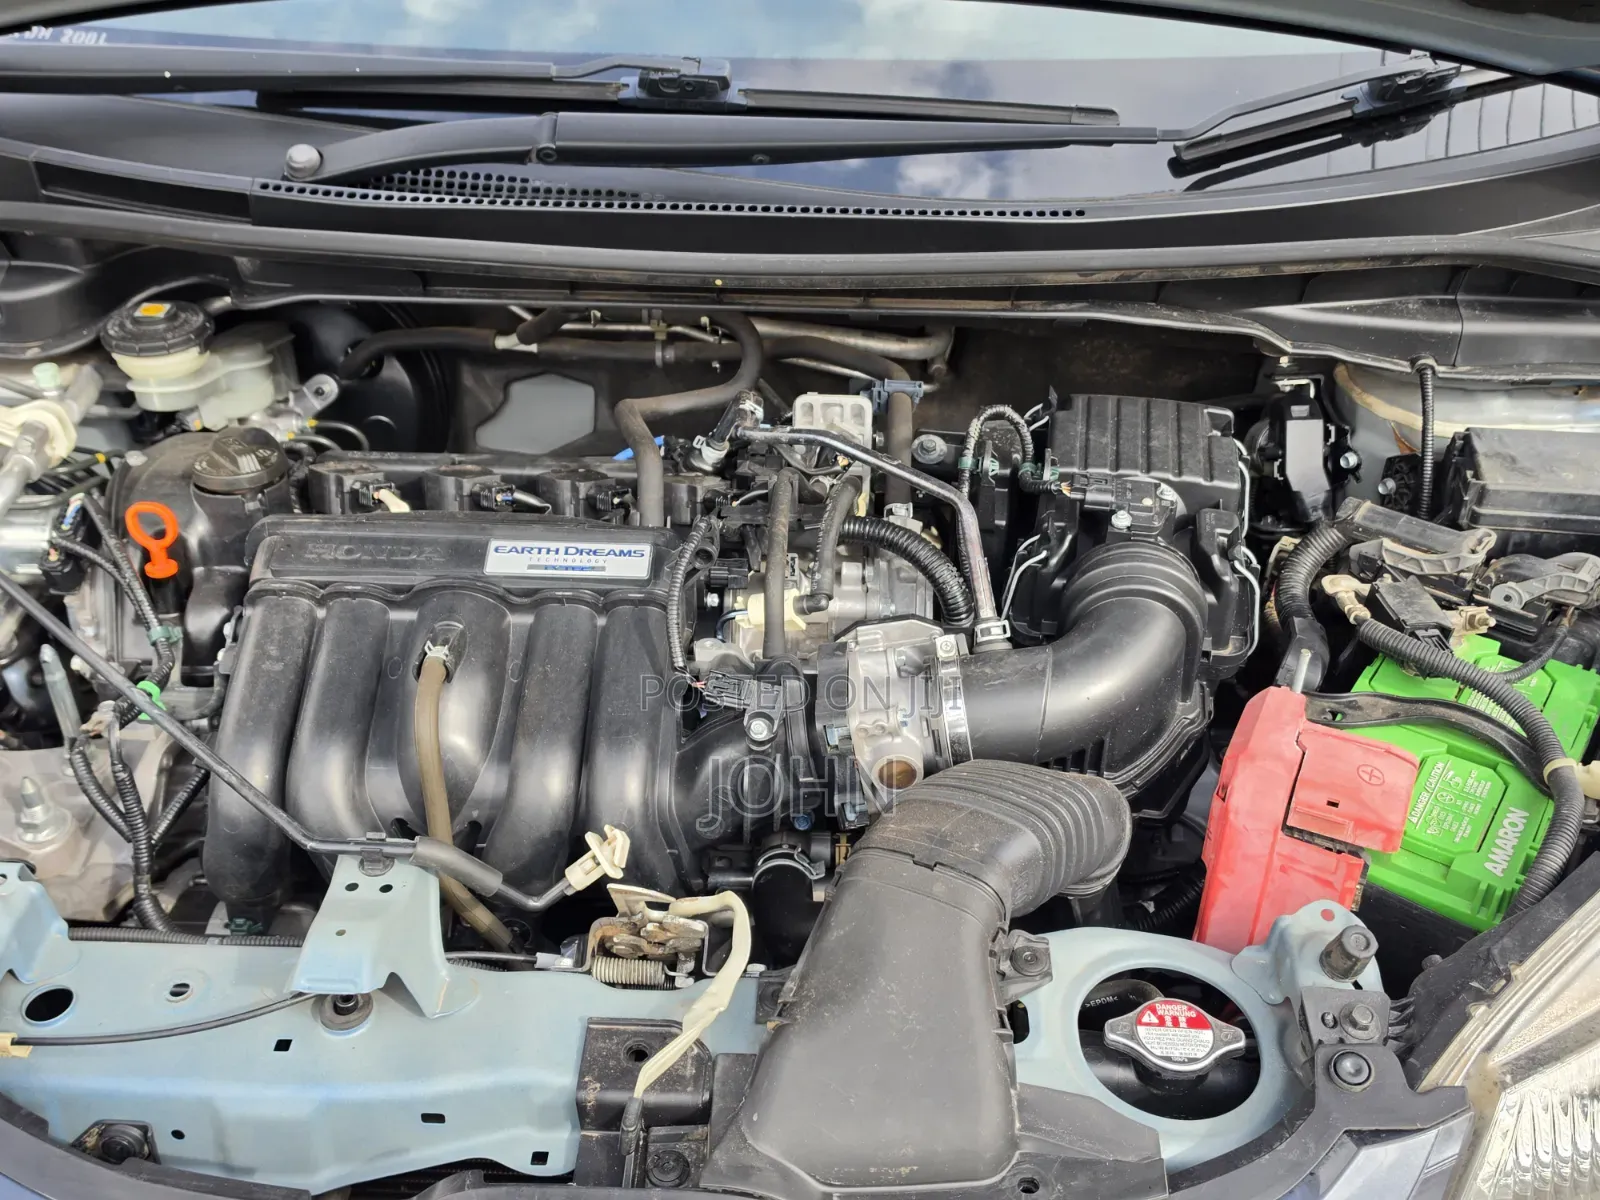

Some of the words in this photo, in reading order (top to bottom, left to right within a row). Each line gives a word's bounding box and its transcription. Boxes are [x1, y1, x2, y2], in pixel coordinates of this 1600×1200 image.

[303, 543, 446, 561] HONDA
[494, 545, 559, 555] EARTH
[1484, 807, 1529, 877] AMARON
[1155, 1003, 1187, 1011] DANGER
[1157, 1009, 1197, 1018] WARNUNG
